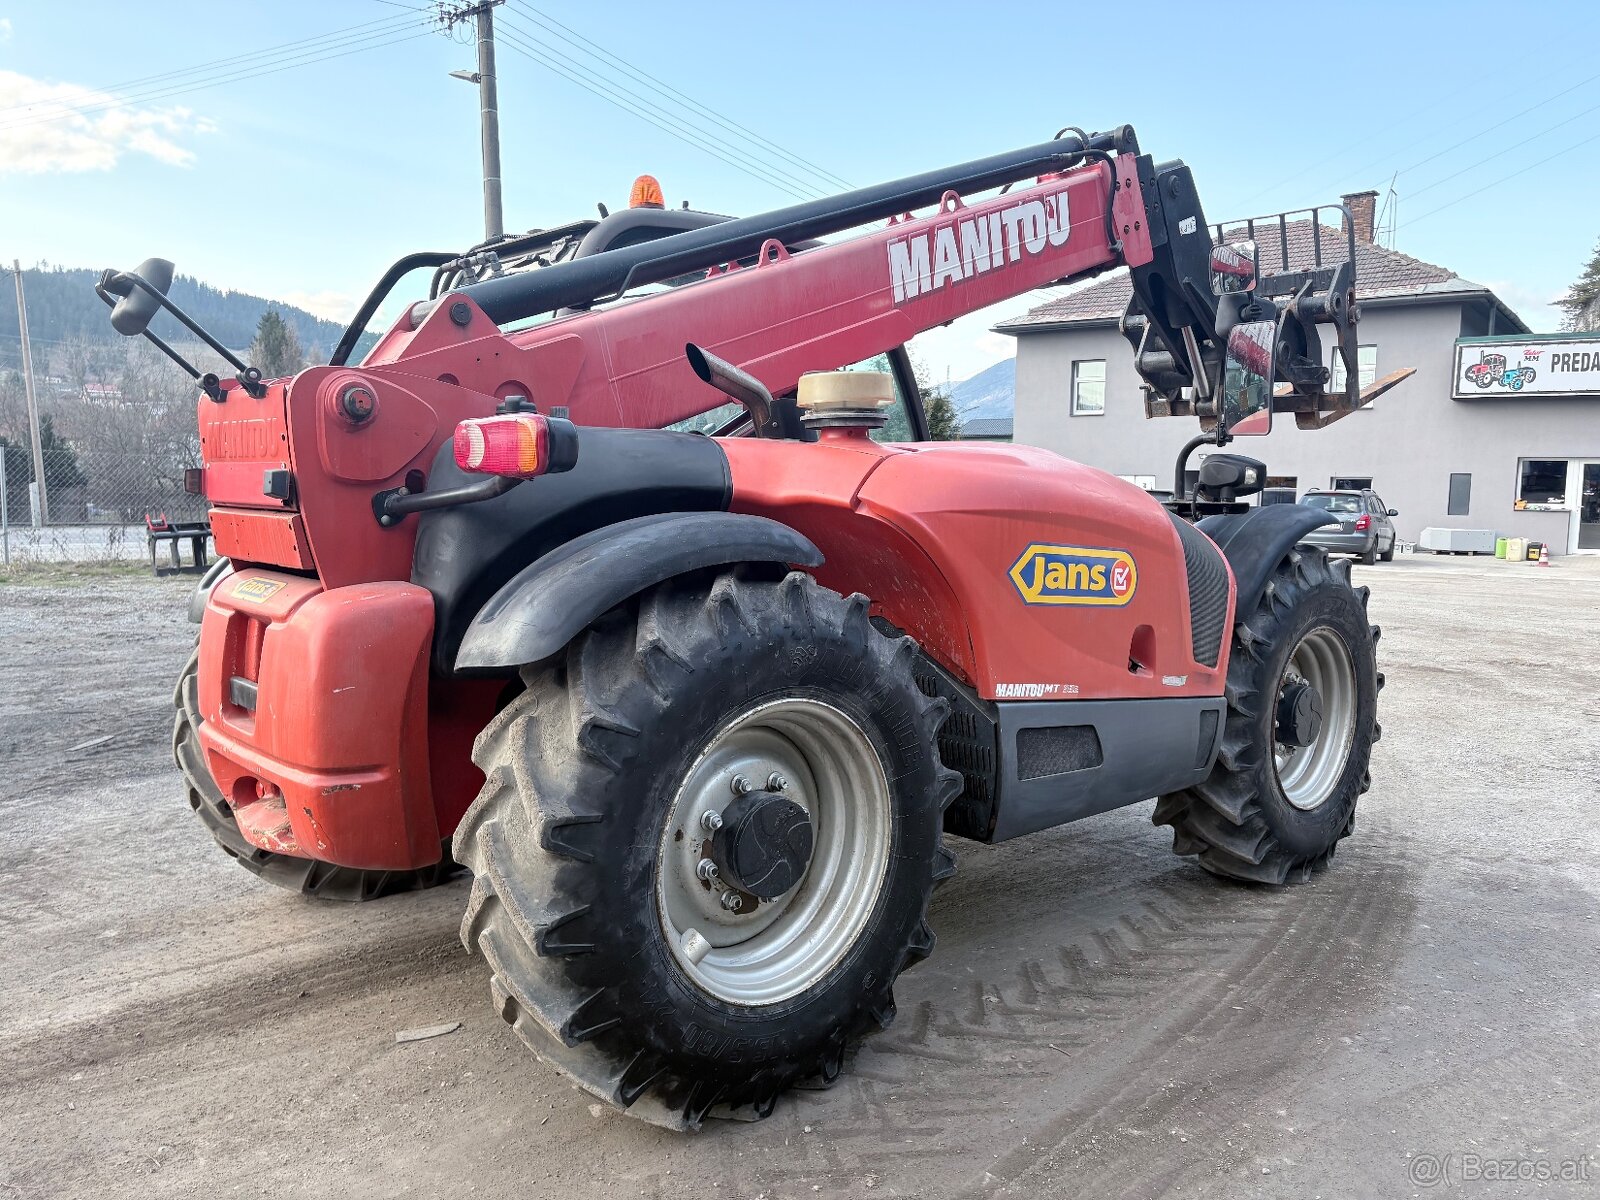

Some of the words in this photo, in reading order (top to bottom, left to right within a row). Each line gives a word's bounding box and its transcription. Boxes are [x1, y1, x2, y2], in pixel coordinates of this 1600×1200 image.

[887, 191, 1070, 304] MANITOU
[1551, 352, 1600, 373] PREDA
[206, 416, 281, 459] MANITOU
[1027, 556, 1106, 596] Jans
[995, 683, 1045, 698] MANITOU
[1045, 683, 1061, 694] MT
